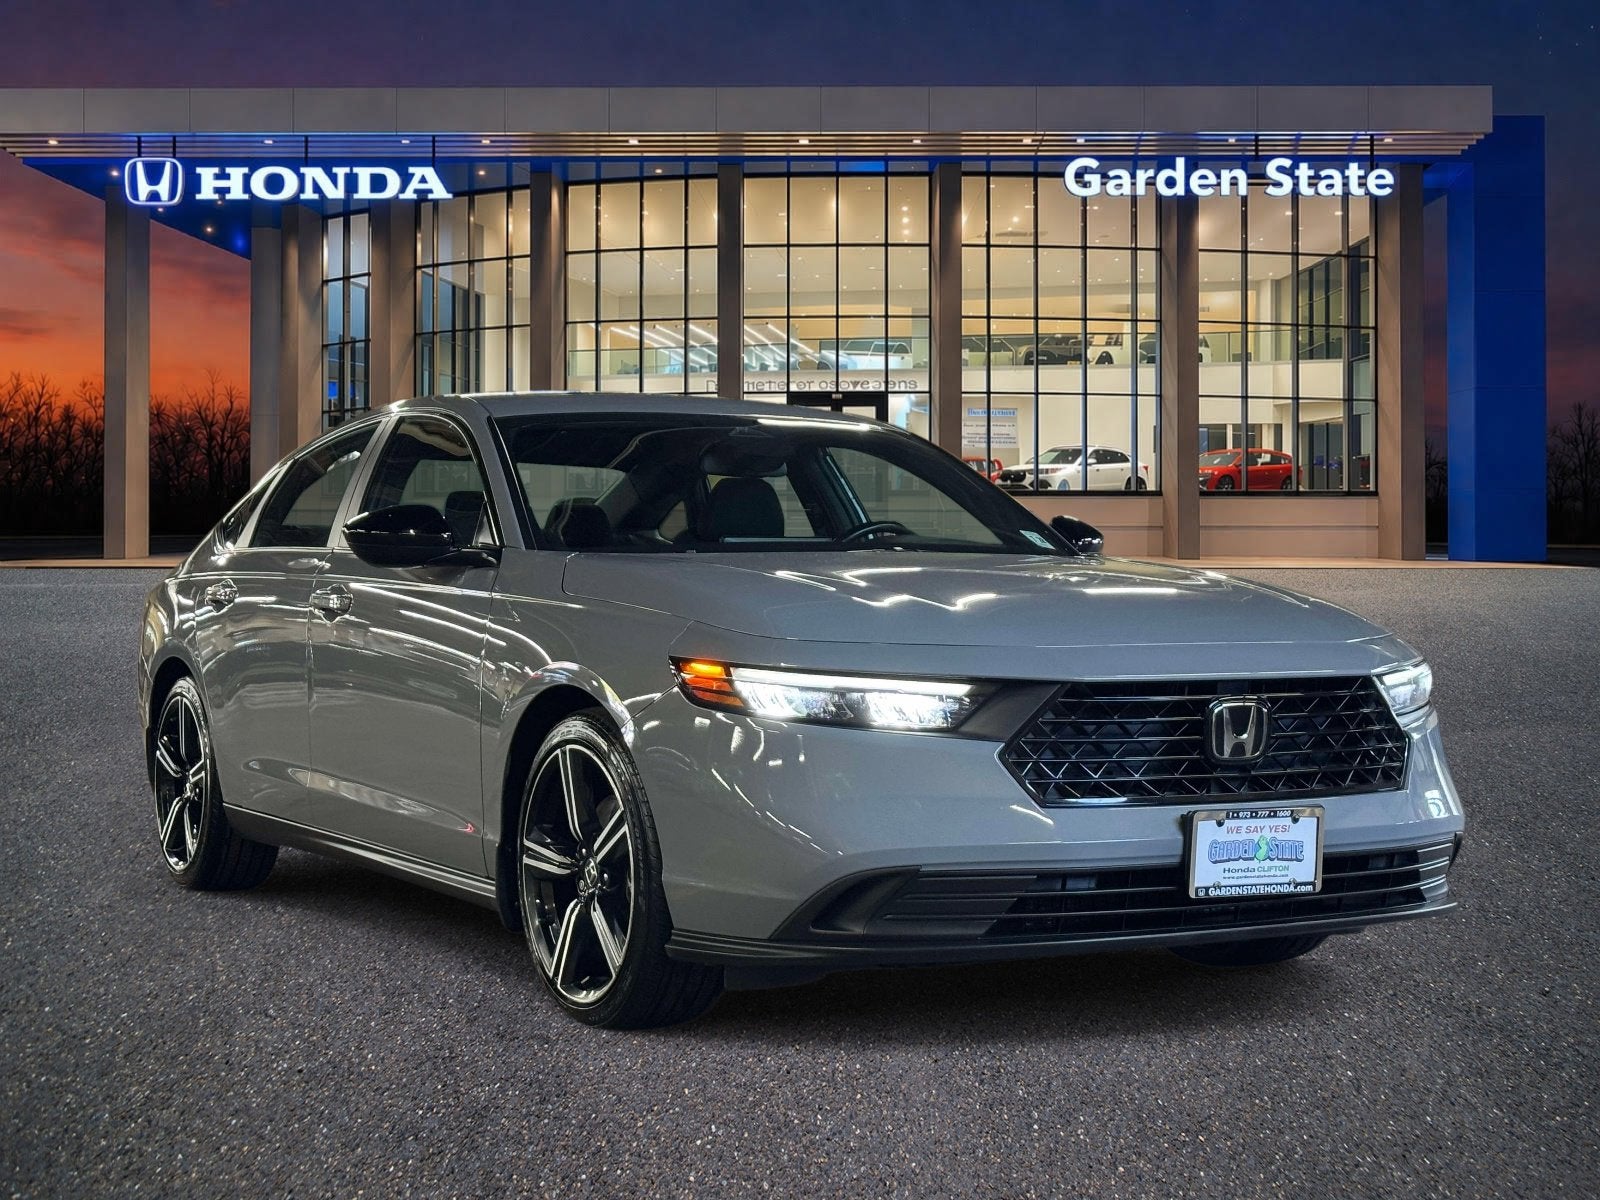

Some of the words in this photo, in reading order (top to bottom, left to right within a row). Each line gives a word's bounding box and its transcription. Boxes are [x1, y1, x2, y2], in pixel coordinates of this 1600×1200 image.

[195, 166, 453, 200] HONDA
[1064, 157, 1247, 197] Garden
[1264, 157, 1395, 197] State
[1226, 826, 1242, 834] WE
[1245, 825, 1265, 833] SAY
[1269, 825, 1290, 833] YES!
[1208, 839, 1256, 864] GARDEN
[1267, 837, 1304, 862] STATE
[1208, 884, 1313, 896] GARDENSTATEHONDA.com
